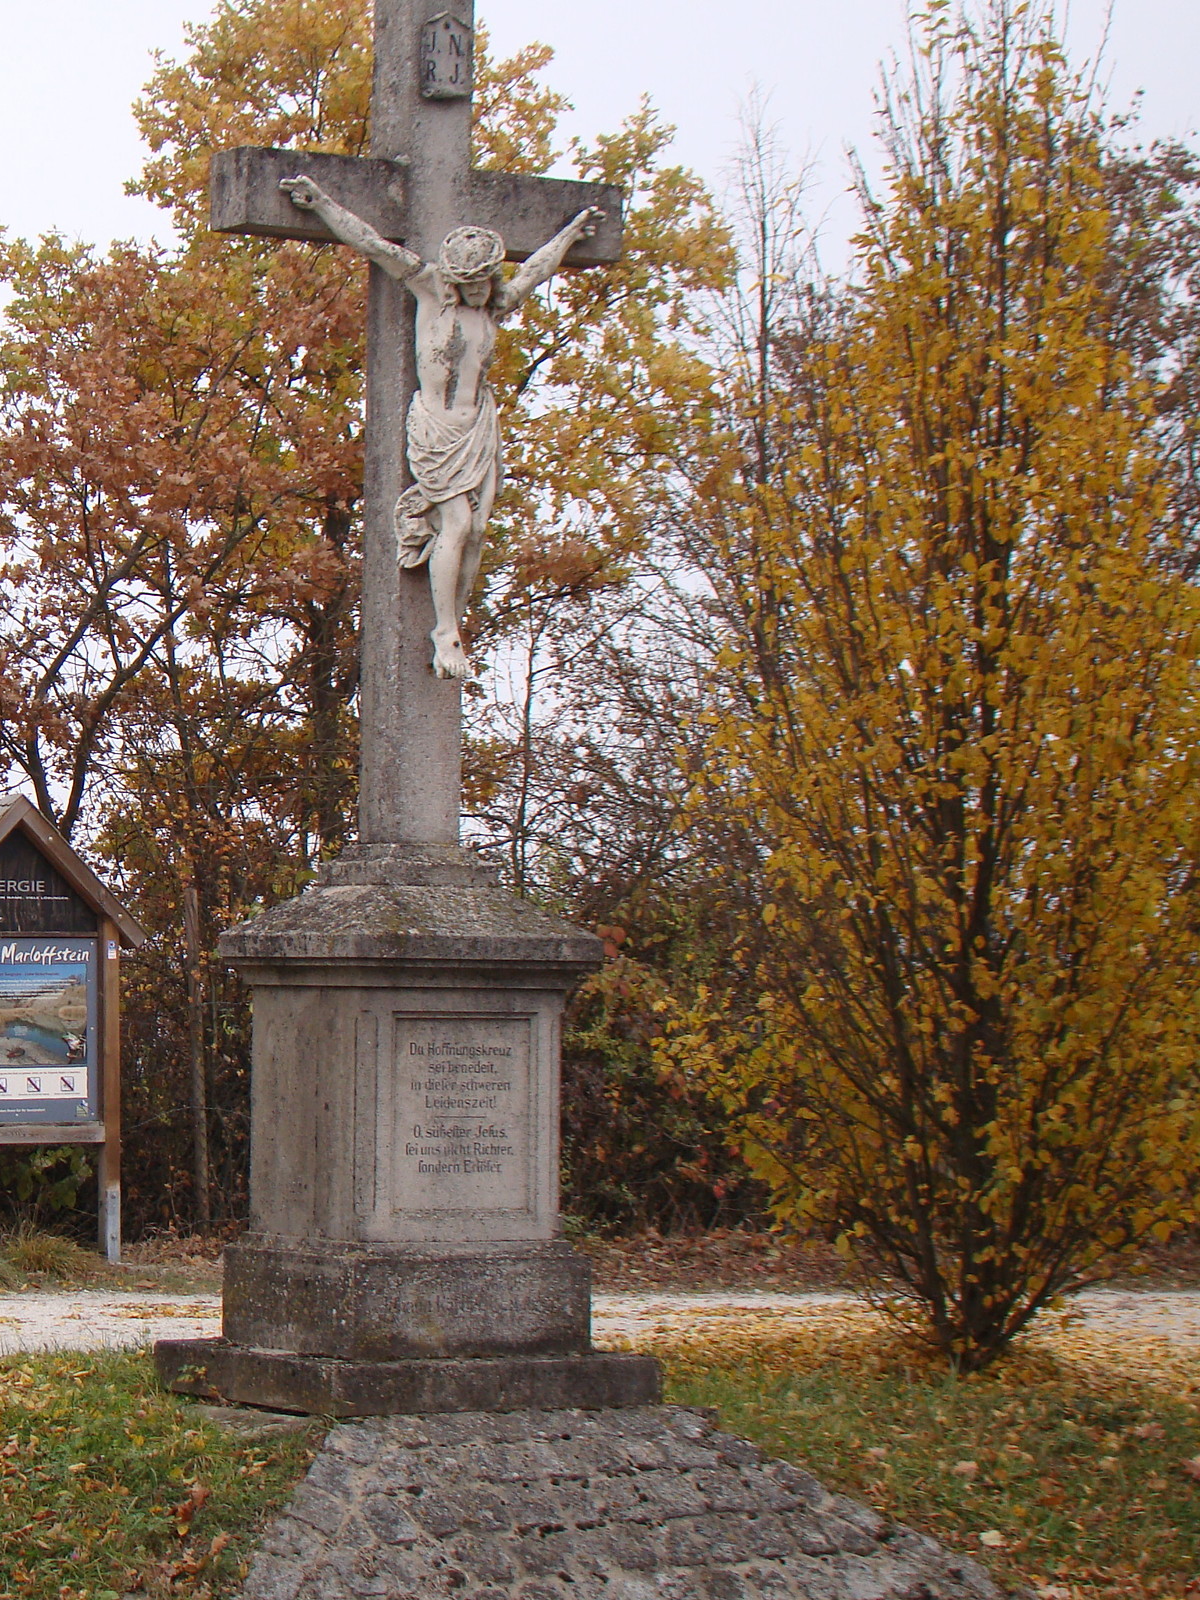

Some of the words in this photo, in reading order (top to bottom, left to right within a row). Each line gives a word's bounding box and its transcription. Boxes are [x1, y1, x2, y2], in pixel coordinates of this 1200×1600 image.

[1, 943, 90, 965] Marloffstein
[409, 1042, 424, 1056] Du
[427, 1041, 512, 1058] Hoffnungskreuz
[428, 1062, 445, 1074] sei
[411, 1080, 421, 1091] in
[461, 1079, 511, 1092] schweren
[425, 1095, 497, 1109] Leidenszeit!
[420, 1145, 441, 1156] uns
